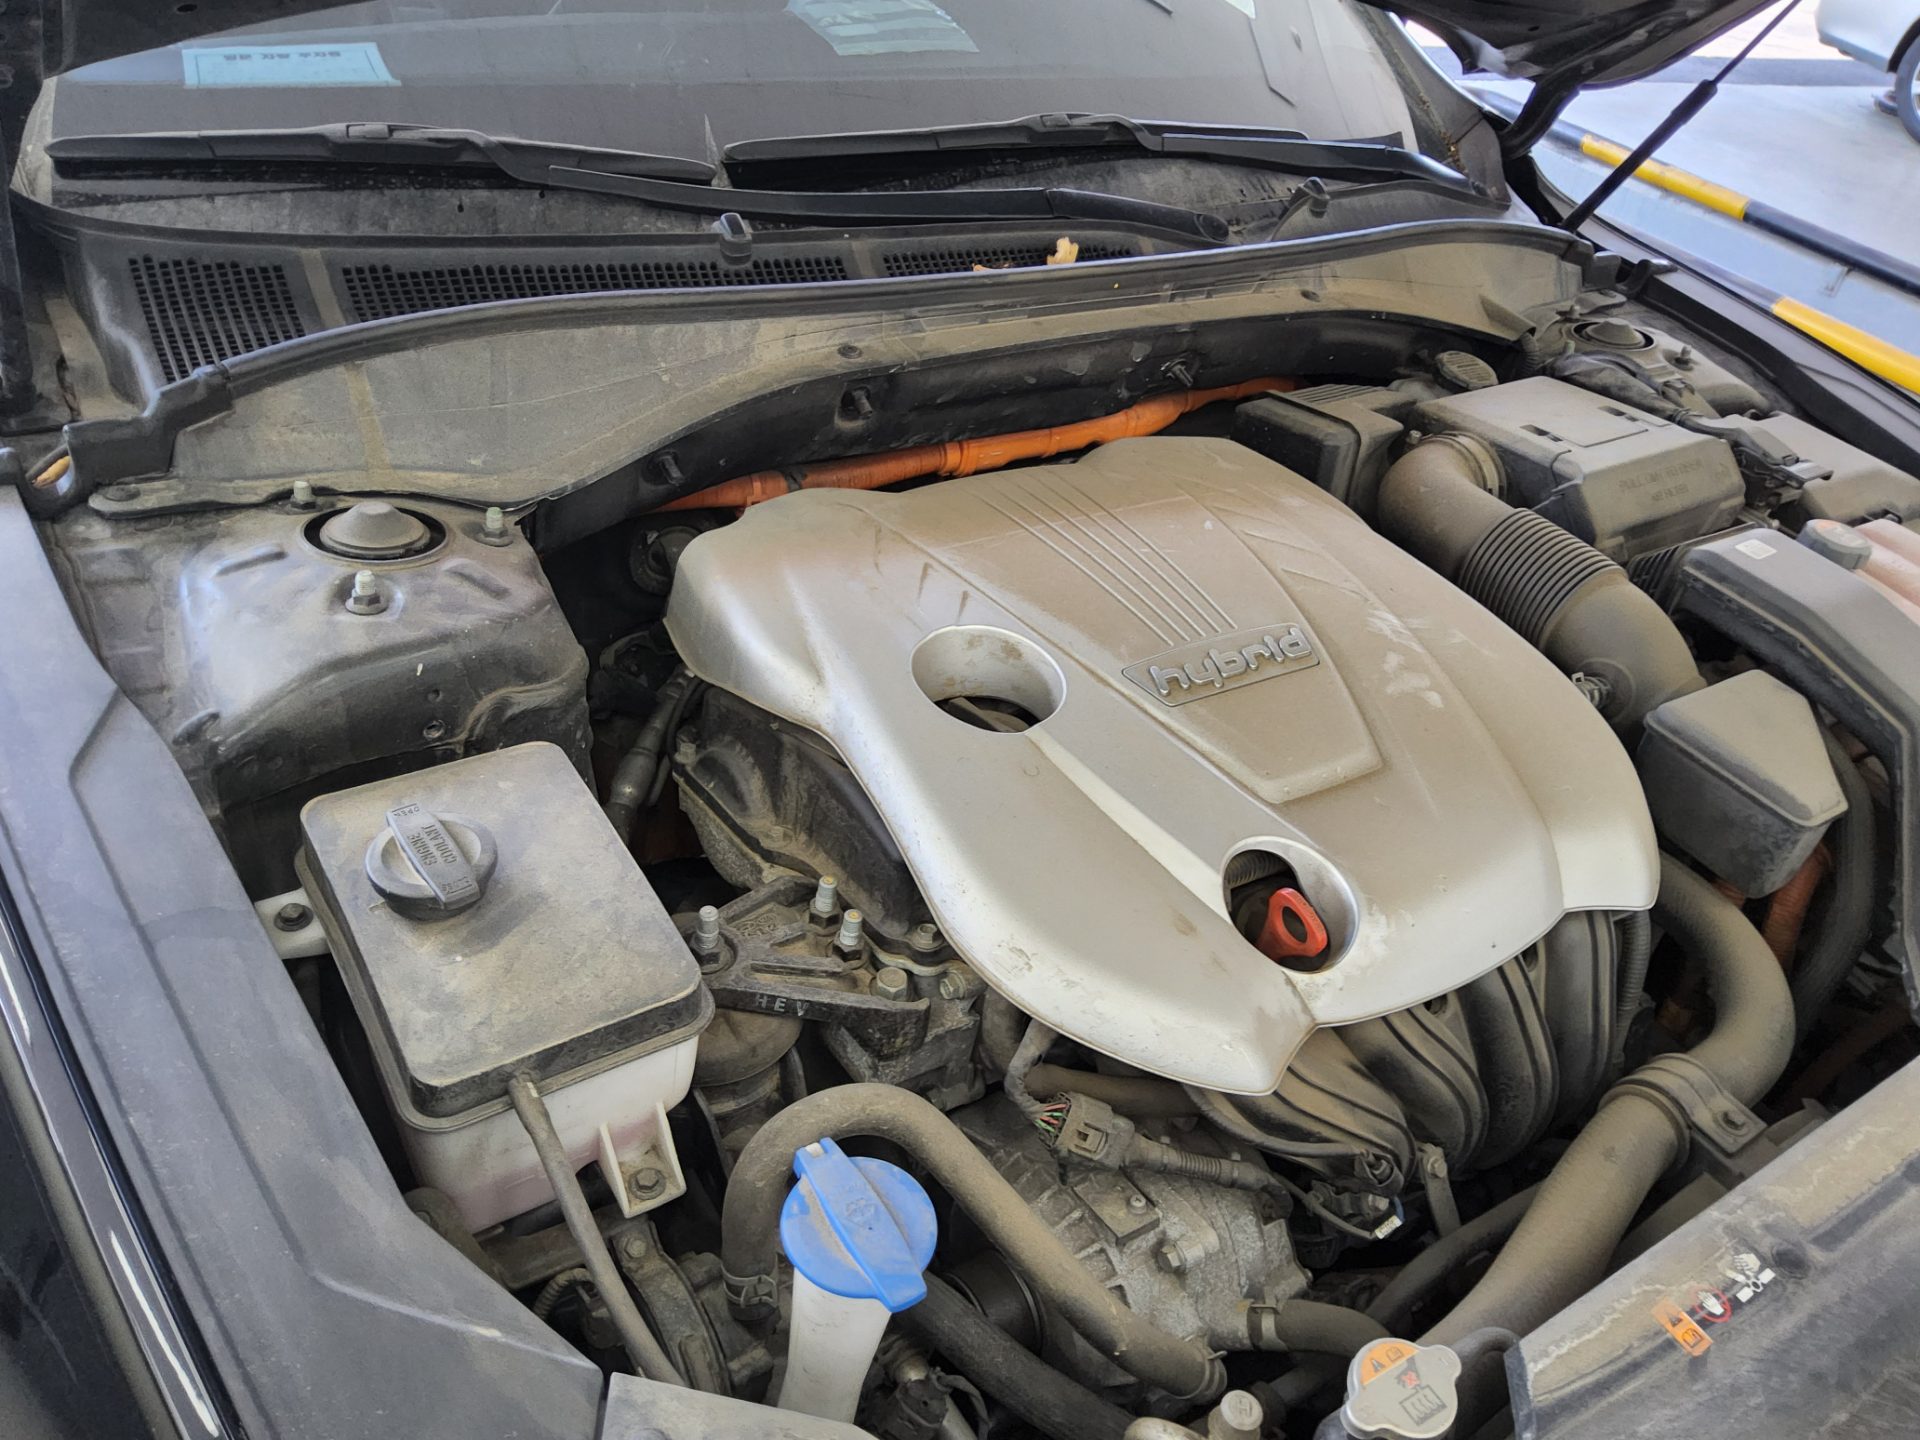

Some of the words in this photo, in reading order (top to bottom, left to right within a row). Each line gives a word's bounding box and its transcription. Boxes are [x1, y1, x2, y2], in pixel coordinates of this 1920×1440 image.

[1148, 625, 1313, 697] hybrid
[407, 831, 438, 867] ENGINE
[421, 824, 458, 864] COOLANT
[756, 994, 810, 1017] HEV
